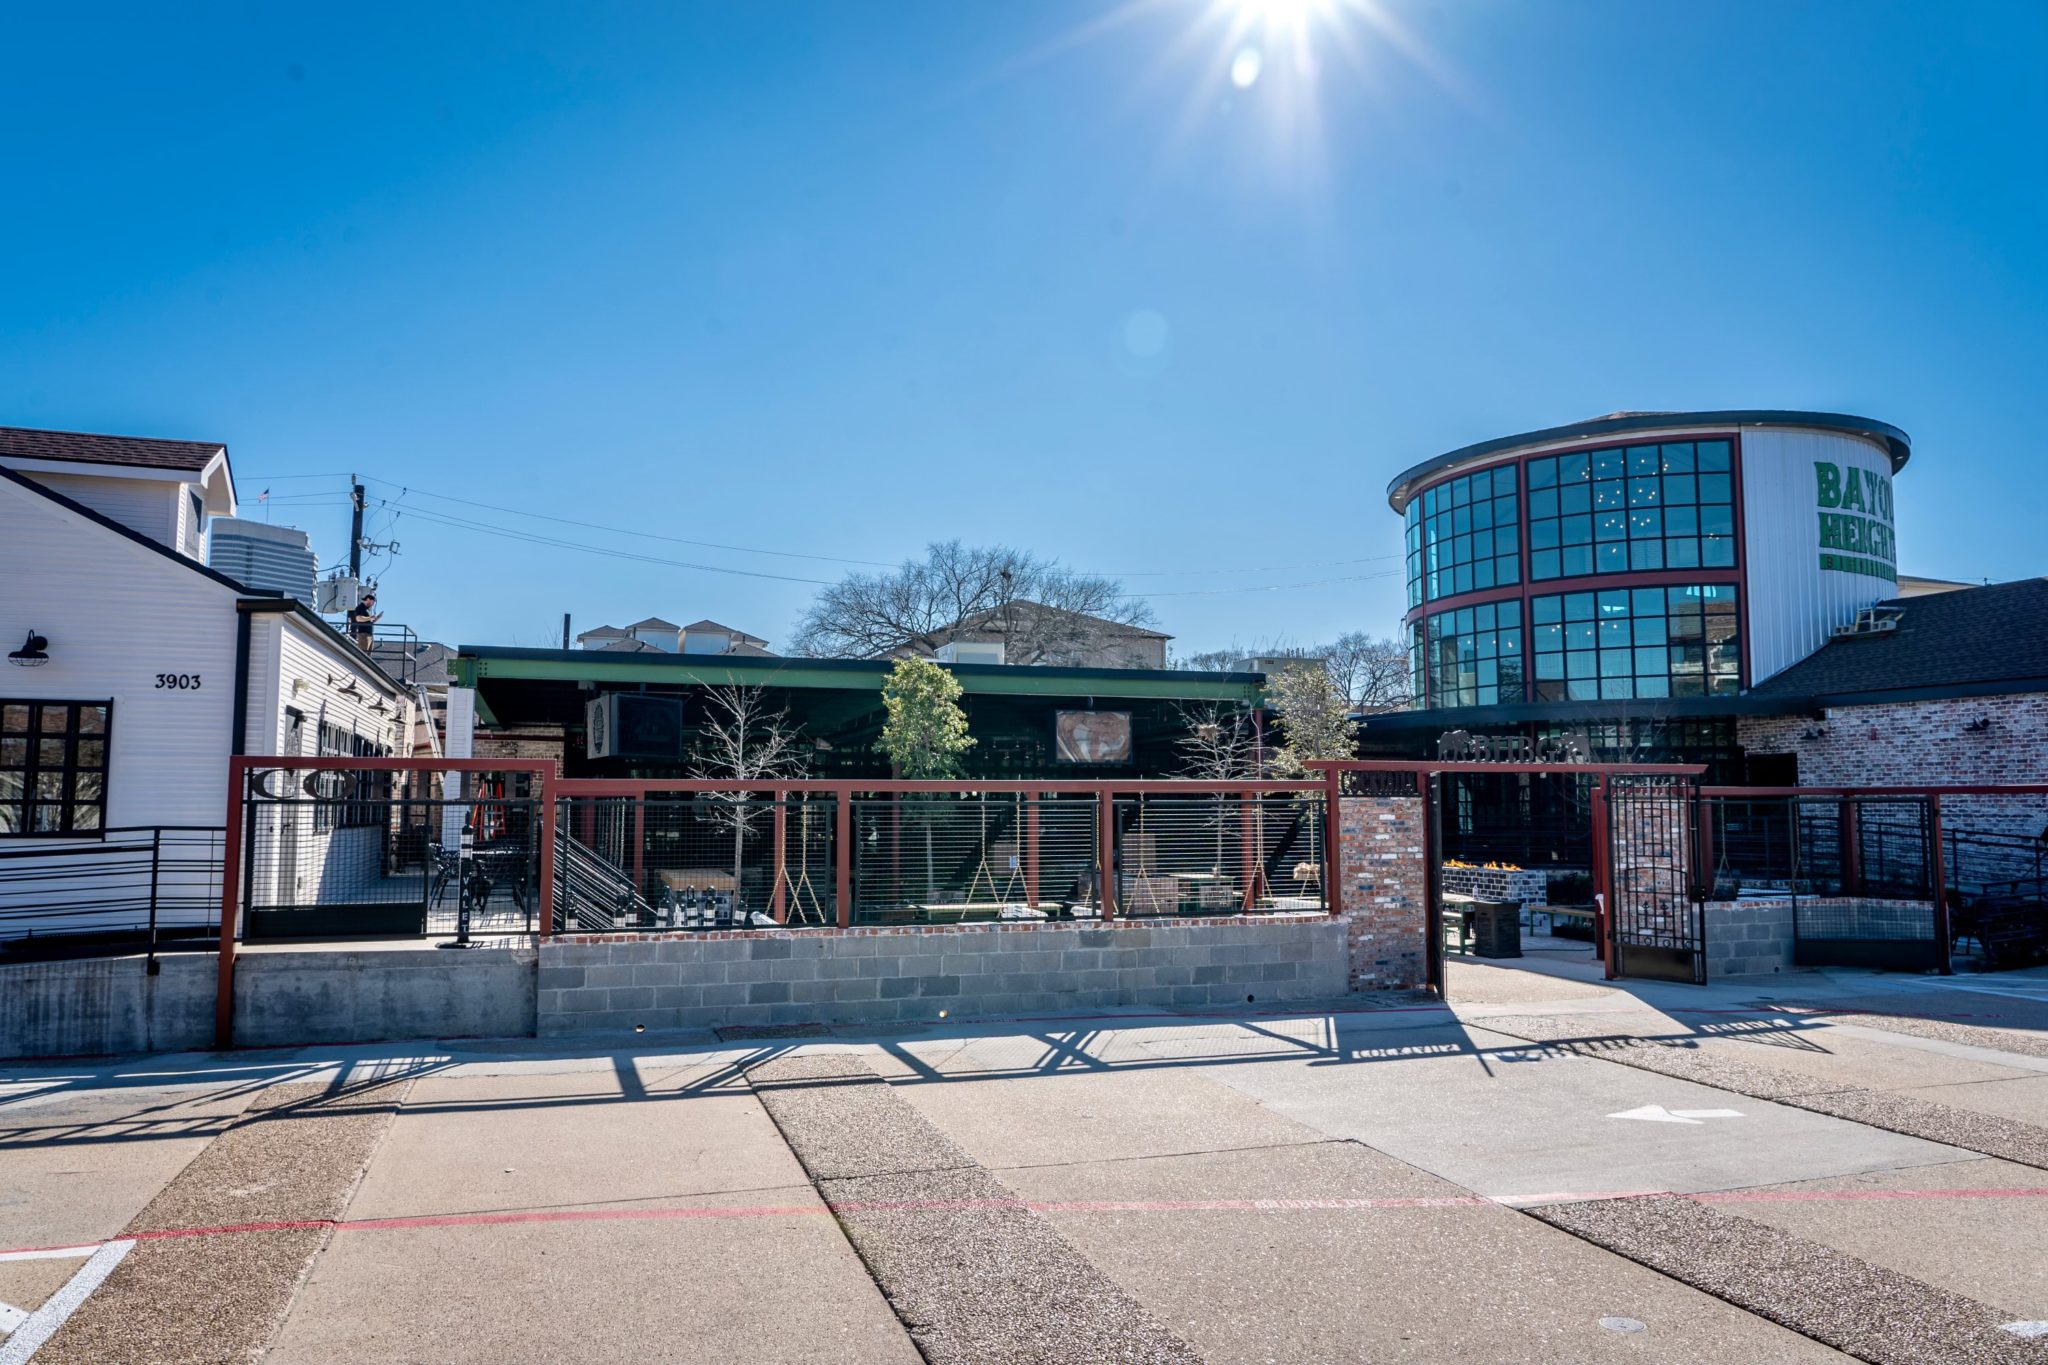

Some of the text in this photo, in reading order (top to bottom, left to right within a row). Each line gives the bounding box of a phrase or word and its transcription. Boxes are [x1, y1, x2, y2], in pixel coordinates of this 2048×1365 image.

[1818, 512, 1897, 564] HEIGHT
[155, 674, 201, 690] 3903
[1473, 735, 1562, 763] BHBG
